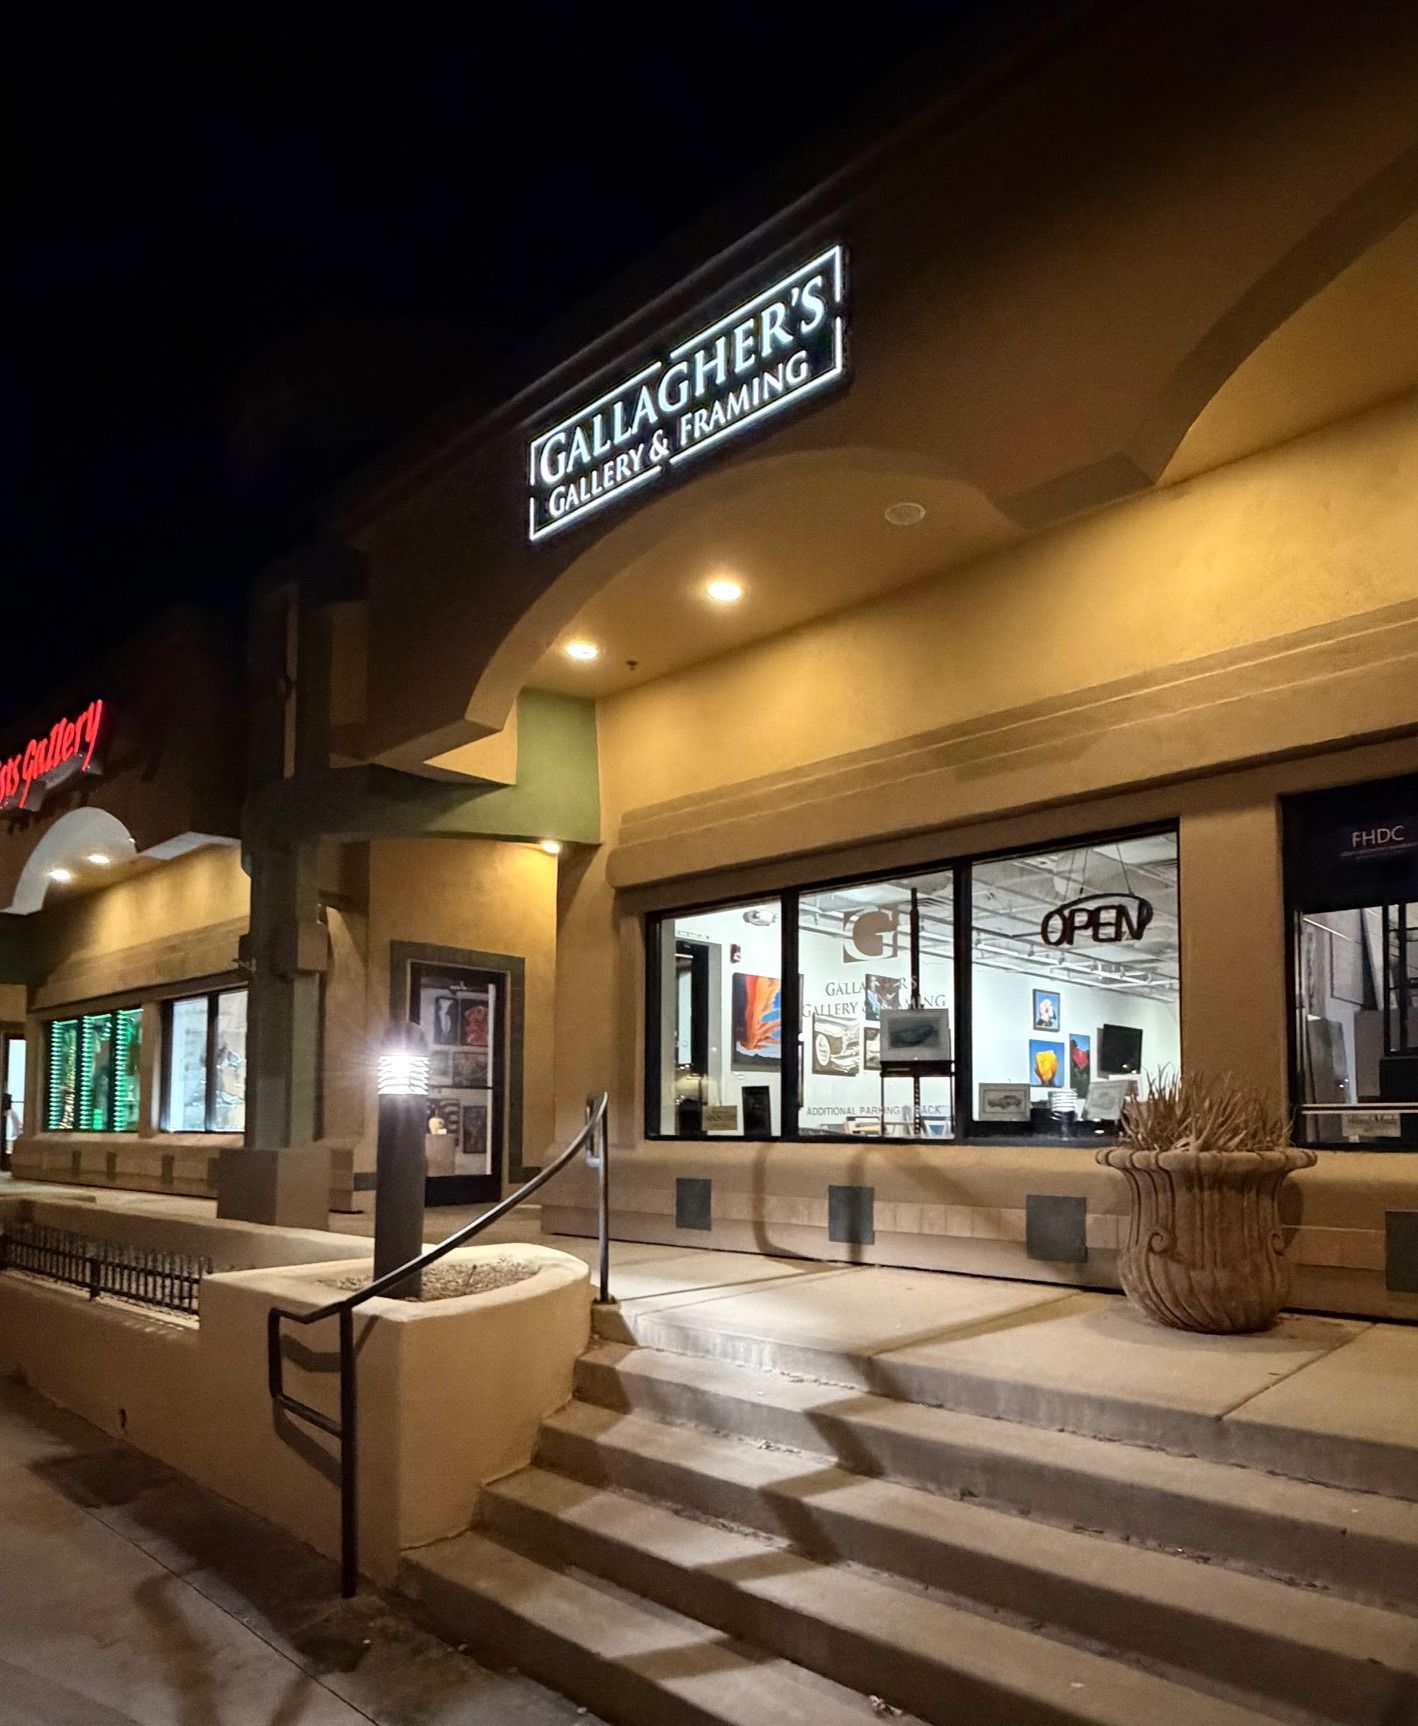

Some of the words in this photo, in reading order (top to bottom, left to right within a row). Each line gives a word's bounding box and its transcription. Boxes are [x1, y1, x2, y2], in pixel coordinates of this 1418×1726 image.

[539, 275, 826, 485] GALLAGHER'S
[548, 442, 646, 520] GALLERY
[649, 428, 671, 463] &
[679, 349, 810, 447] FRAMING
[1351, 825, 1405, 848] FHDC
[843, 907, 897, 961] G
[1042, 903, 1151, 946] OPEN
[801, 1001, 858, 1018] GALLERY
[806, 1105, 857, 1117] ADDITIONAL
